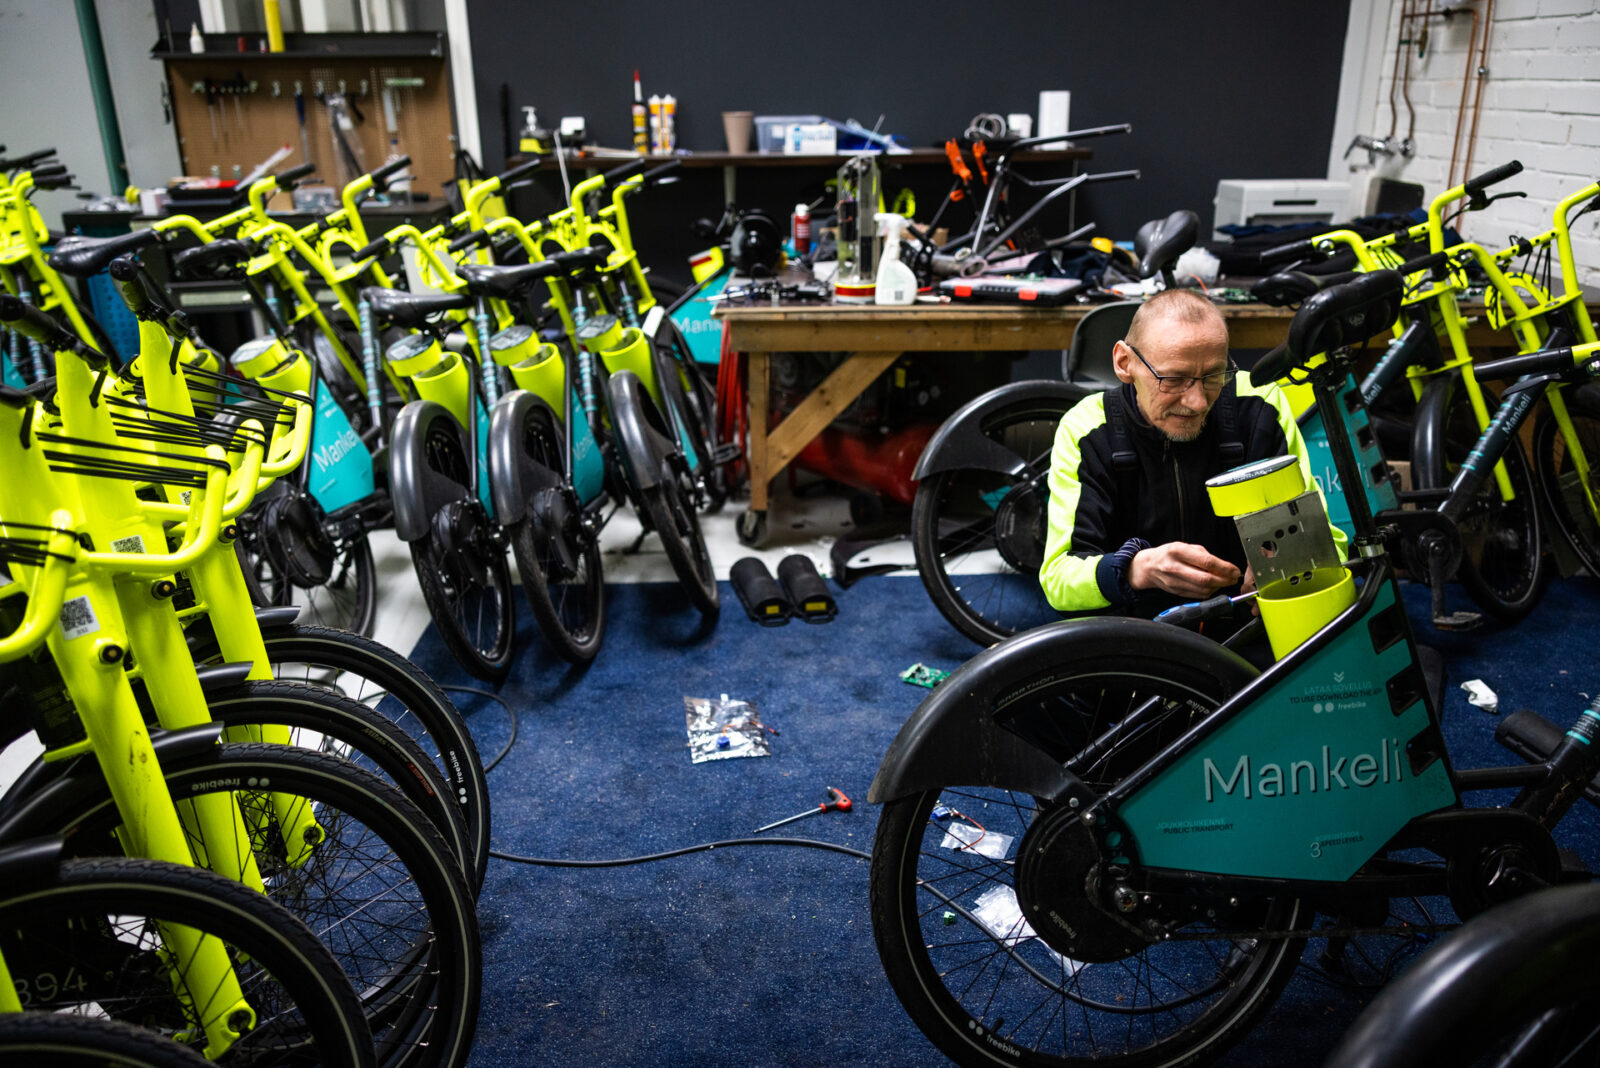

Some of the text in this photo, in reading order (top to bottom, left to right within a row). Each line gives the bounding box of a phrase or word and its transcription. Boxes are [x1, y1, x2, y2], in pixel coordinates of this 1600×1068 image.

[1502, 393, 1531, 434] Mankeli
[192, 777, 240, 791] freebike
[449, 750, 464, 784] freebike
[1203, 737, 1403, 803] Mankeli
[986, 1033, 1021, 1058] freebike
